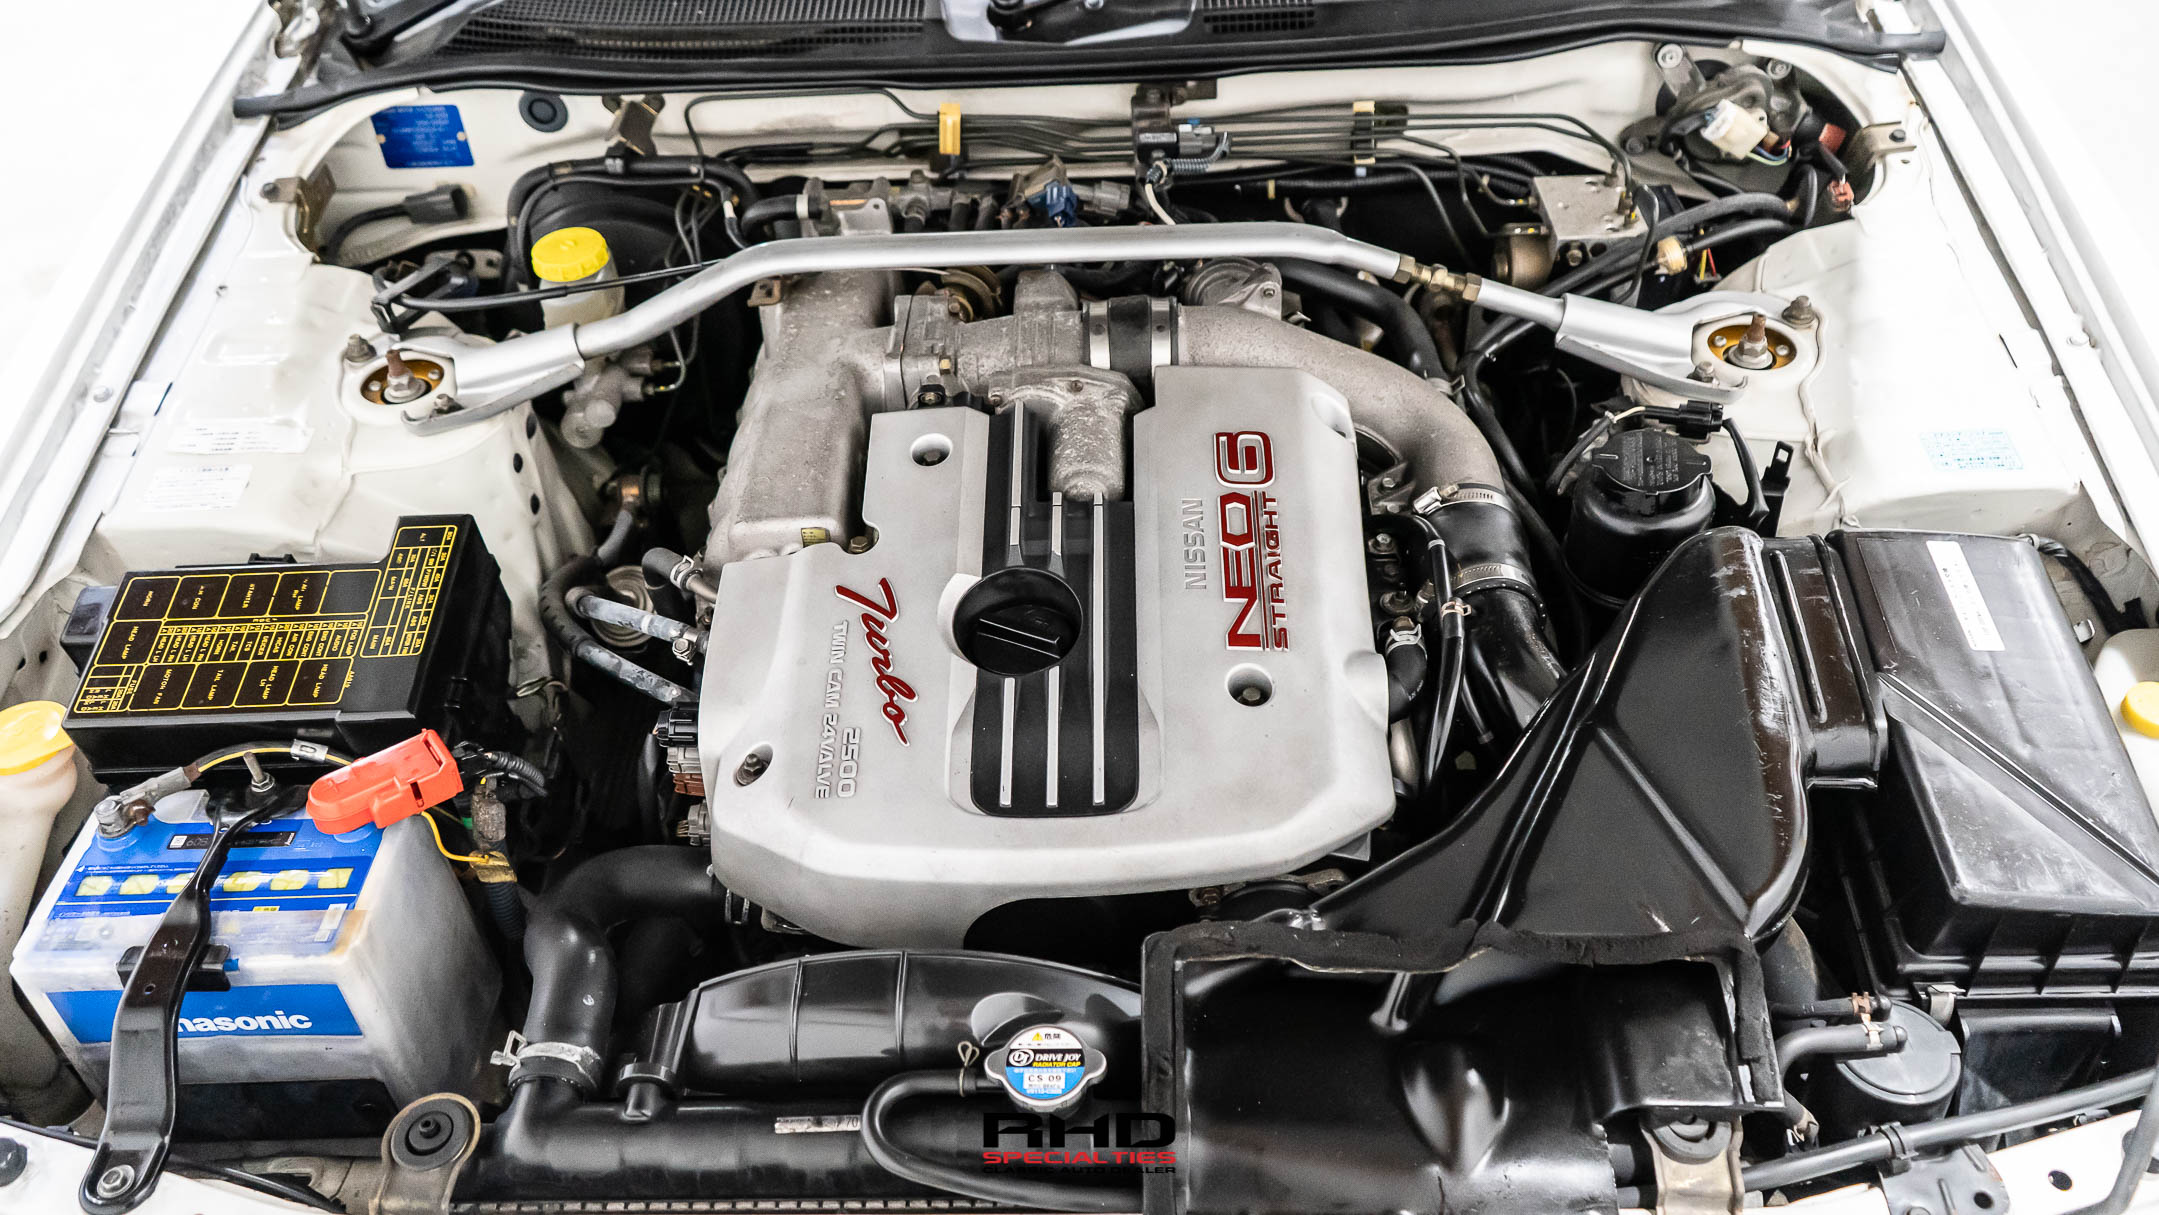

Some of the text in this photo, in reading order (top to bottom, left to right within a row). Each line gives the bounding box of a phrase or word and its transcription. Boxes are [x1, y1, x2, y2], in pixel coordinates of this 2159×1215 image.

[1182, 498, 1207, 590] NISSAN
[1262, 491, 1289, 651] STRAIGHT
[143, 591, 154, 607] HORN
[192, 597, 201, 609] CON
[295, 595, 303, 610] LAMP
[122, 626, 139, 659] HEAD LAMP
[830, 620, 848, 664] TWIN
[835, 577, 918, 746] Turbo
[127, 680, 136, 695] FUSE
[208, 669, 224, 701] TAIL LAMP
[262, 666, 279, 700] HEAD LAMP
[312, 664, 328, 698] HEAD LAMP
[824, 668, 843, 708] CAM
[153, 692, 164, 704] FAN
[837, 727, 860, 798] 2500
[178, 1010, 312, 1032] nasonic
[1035, 1053, 1081, 1062] DRIVE JOY
